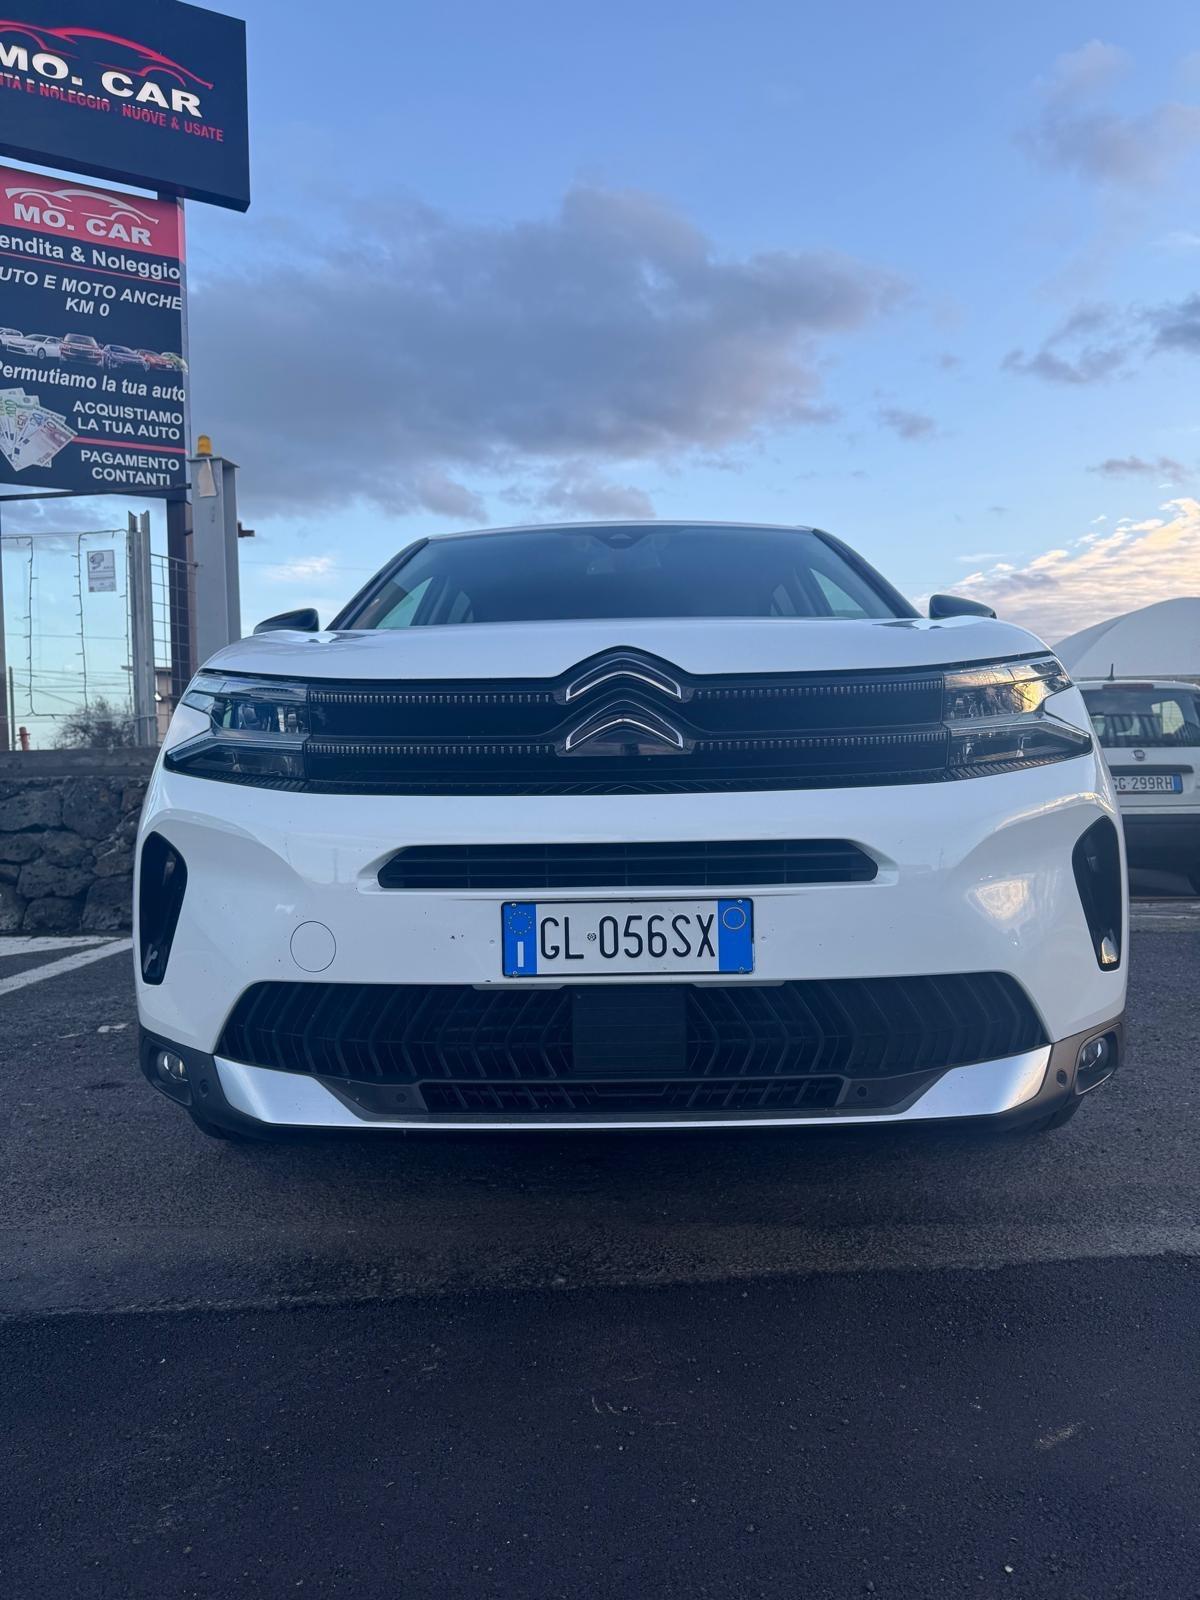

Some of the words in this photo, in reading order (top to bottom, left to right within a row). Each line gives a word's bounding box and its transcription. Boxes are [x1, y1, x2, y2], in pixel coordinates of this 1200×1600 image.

[101, 71, 202, 118] CAR
[26, 79, 35, 94] E
[39, 82, 110, 112] NOLEGGIO
[122, 104, 166, 127] NUOVE
[171, 116, 179, 130] &
[184, 120, 224, 142] USATE
[14, 203, 75, 231] MO.
[86, 218, 152, 246] CAR
[70, 245, 86, 263] &
[93, 250, 180, 280] Noleggio
[43, 274, 57, 289] E
[61, 278, 116, 299] MOTO
[120, 288, 182, 311] ANCHE
[65, 298, 94, 315] KM
[100, 303, 110, 317] 0
[102, 375, 117, 392] la
[122, 380, 147, 396] tua
[152, 384, 186, 402] auto
[73, 400, 183, 425] ACQUISTIAMO
[78, 417, 98, 432] LA
[102, 420, 135, 435] TUA
[138, 424, 180, 440] AUTO
[81, 449, 180, 471] PAGAMENTO
[92, 467, 170, 486] CONTANTI
[1131, 776, 1172, 790] 299RH
[540, 916, 585, 960] GL
[599, 913, 716, 958] 056SX
